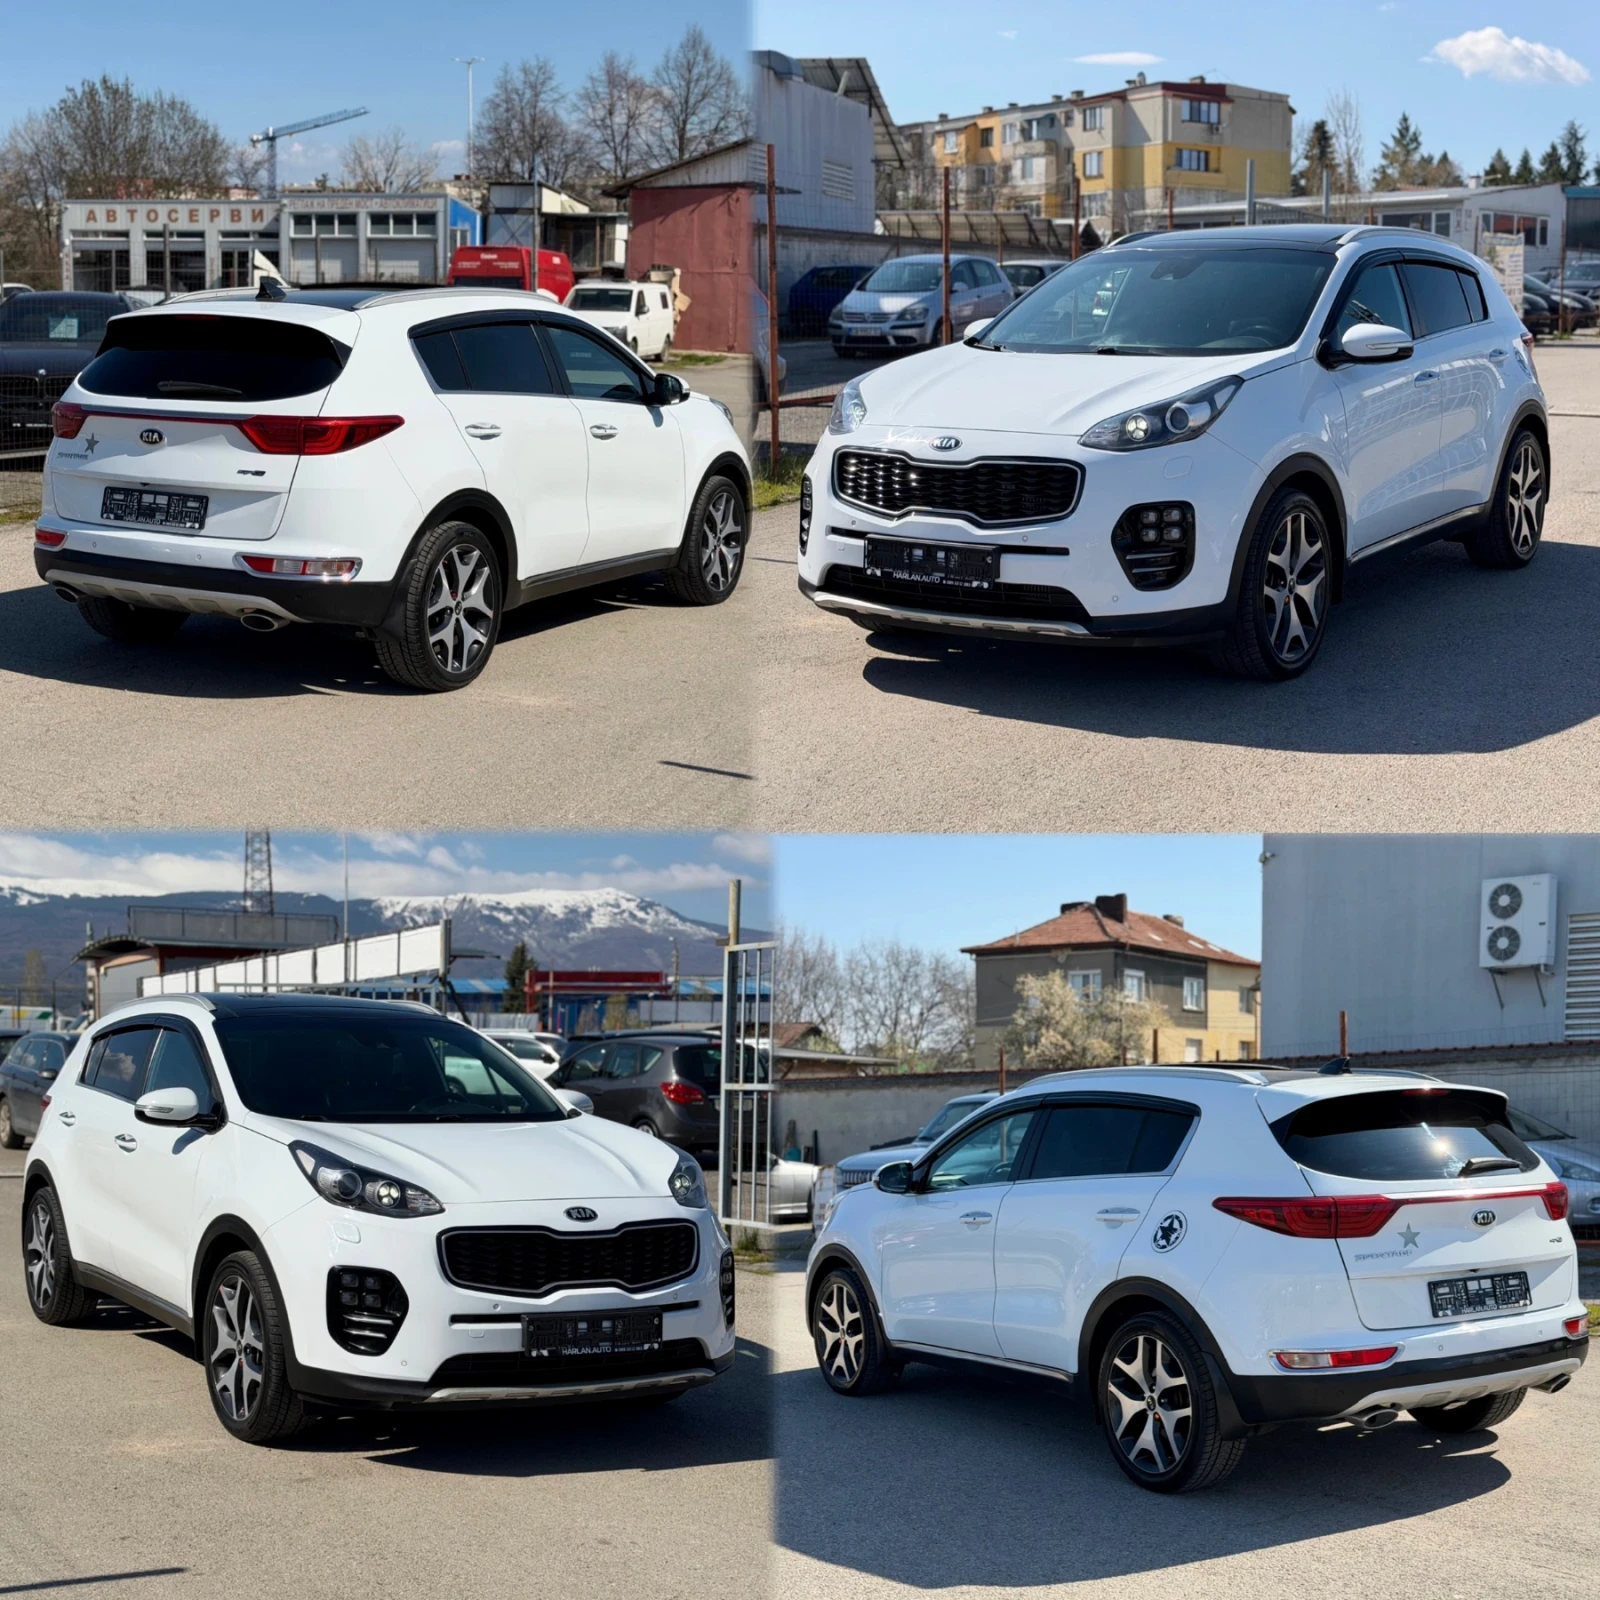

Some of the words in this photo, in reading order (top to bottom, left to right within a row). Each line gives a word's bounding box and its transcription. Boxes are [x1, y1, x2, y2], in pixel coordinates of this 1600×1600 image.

[142, 431, 160, 443] KIA
[932, 438, 956, 448] KIA
[893, 571, 940, 583] HARLAN.AUTO
[569, 1209, 595, 1219] KIA
[1476, 1211, 1494, 1224] KIA
[562, 1345, 612, 1356] HARLAN.AUTO
